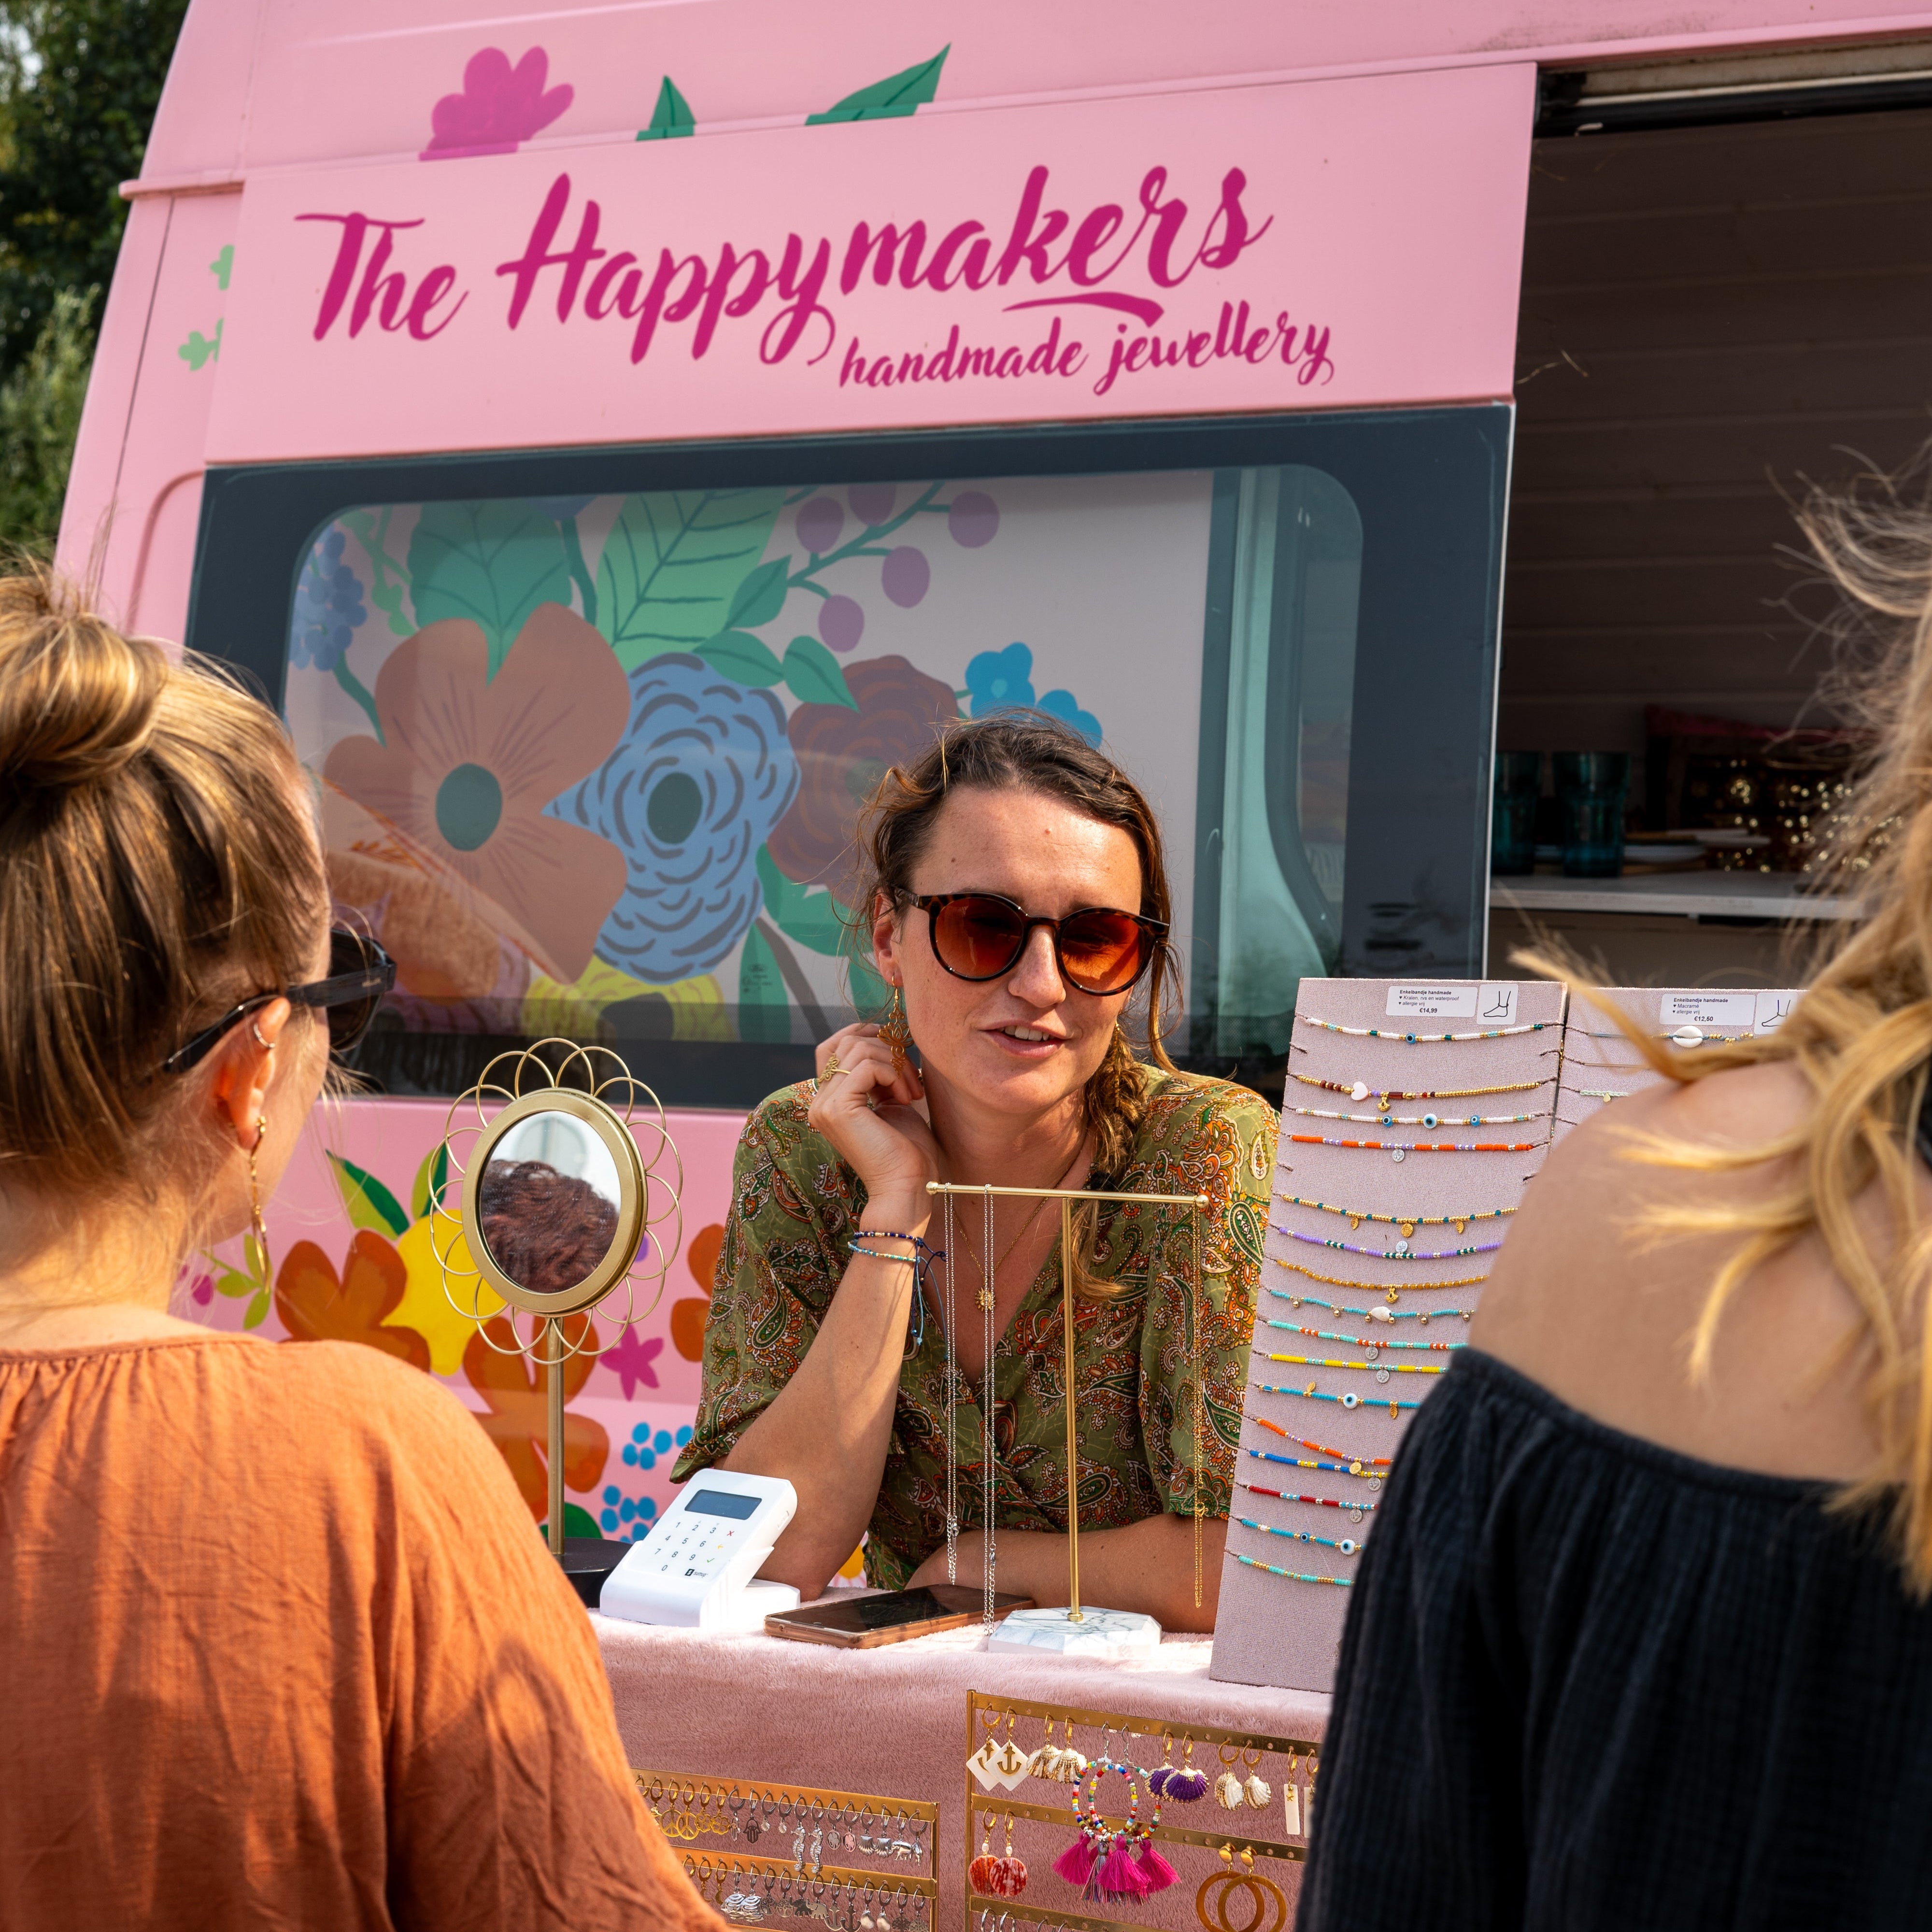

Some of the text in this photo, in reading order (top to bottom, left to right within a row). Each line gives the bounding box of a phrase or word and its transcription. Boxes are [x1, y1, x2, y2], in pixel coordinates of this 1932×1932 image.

[296, 166, 1274, 366] The Happymakers
[839, 300, 1335, 396] handmade jewellery
